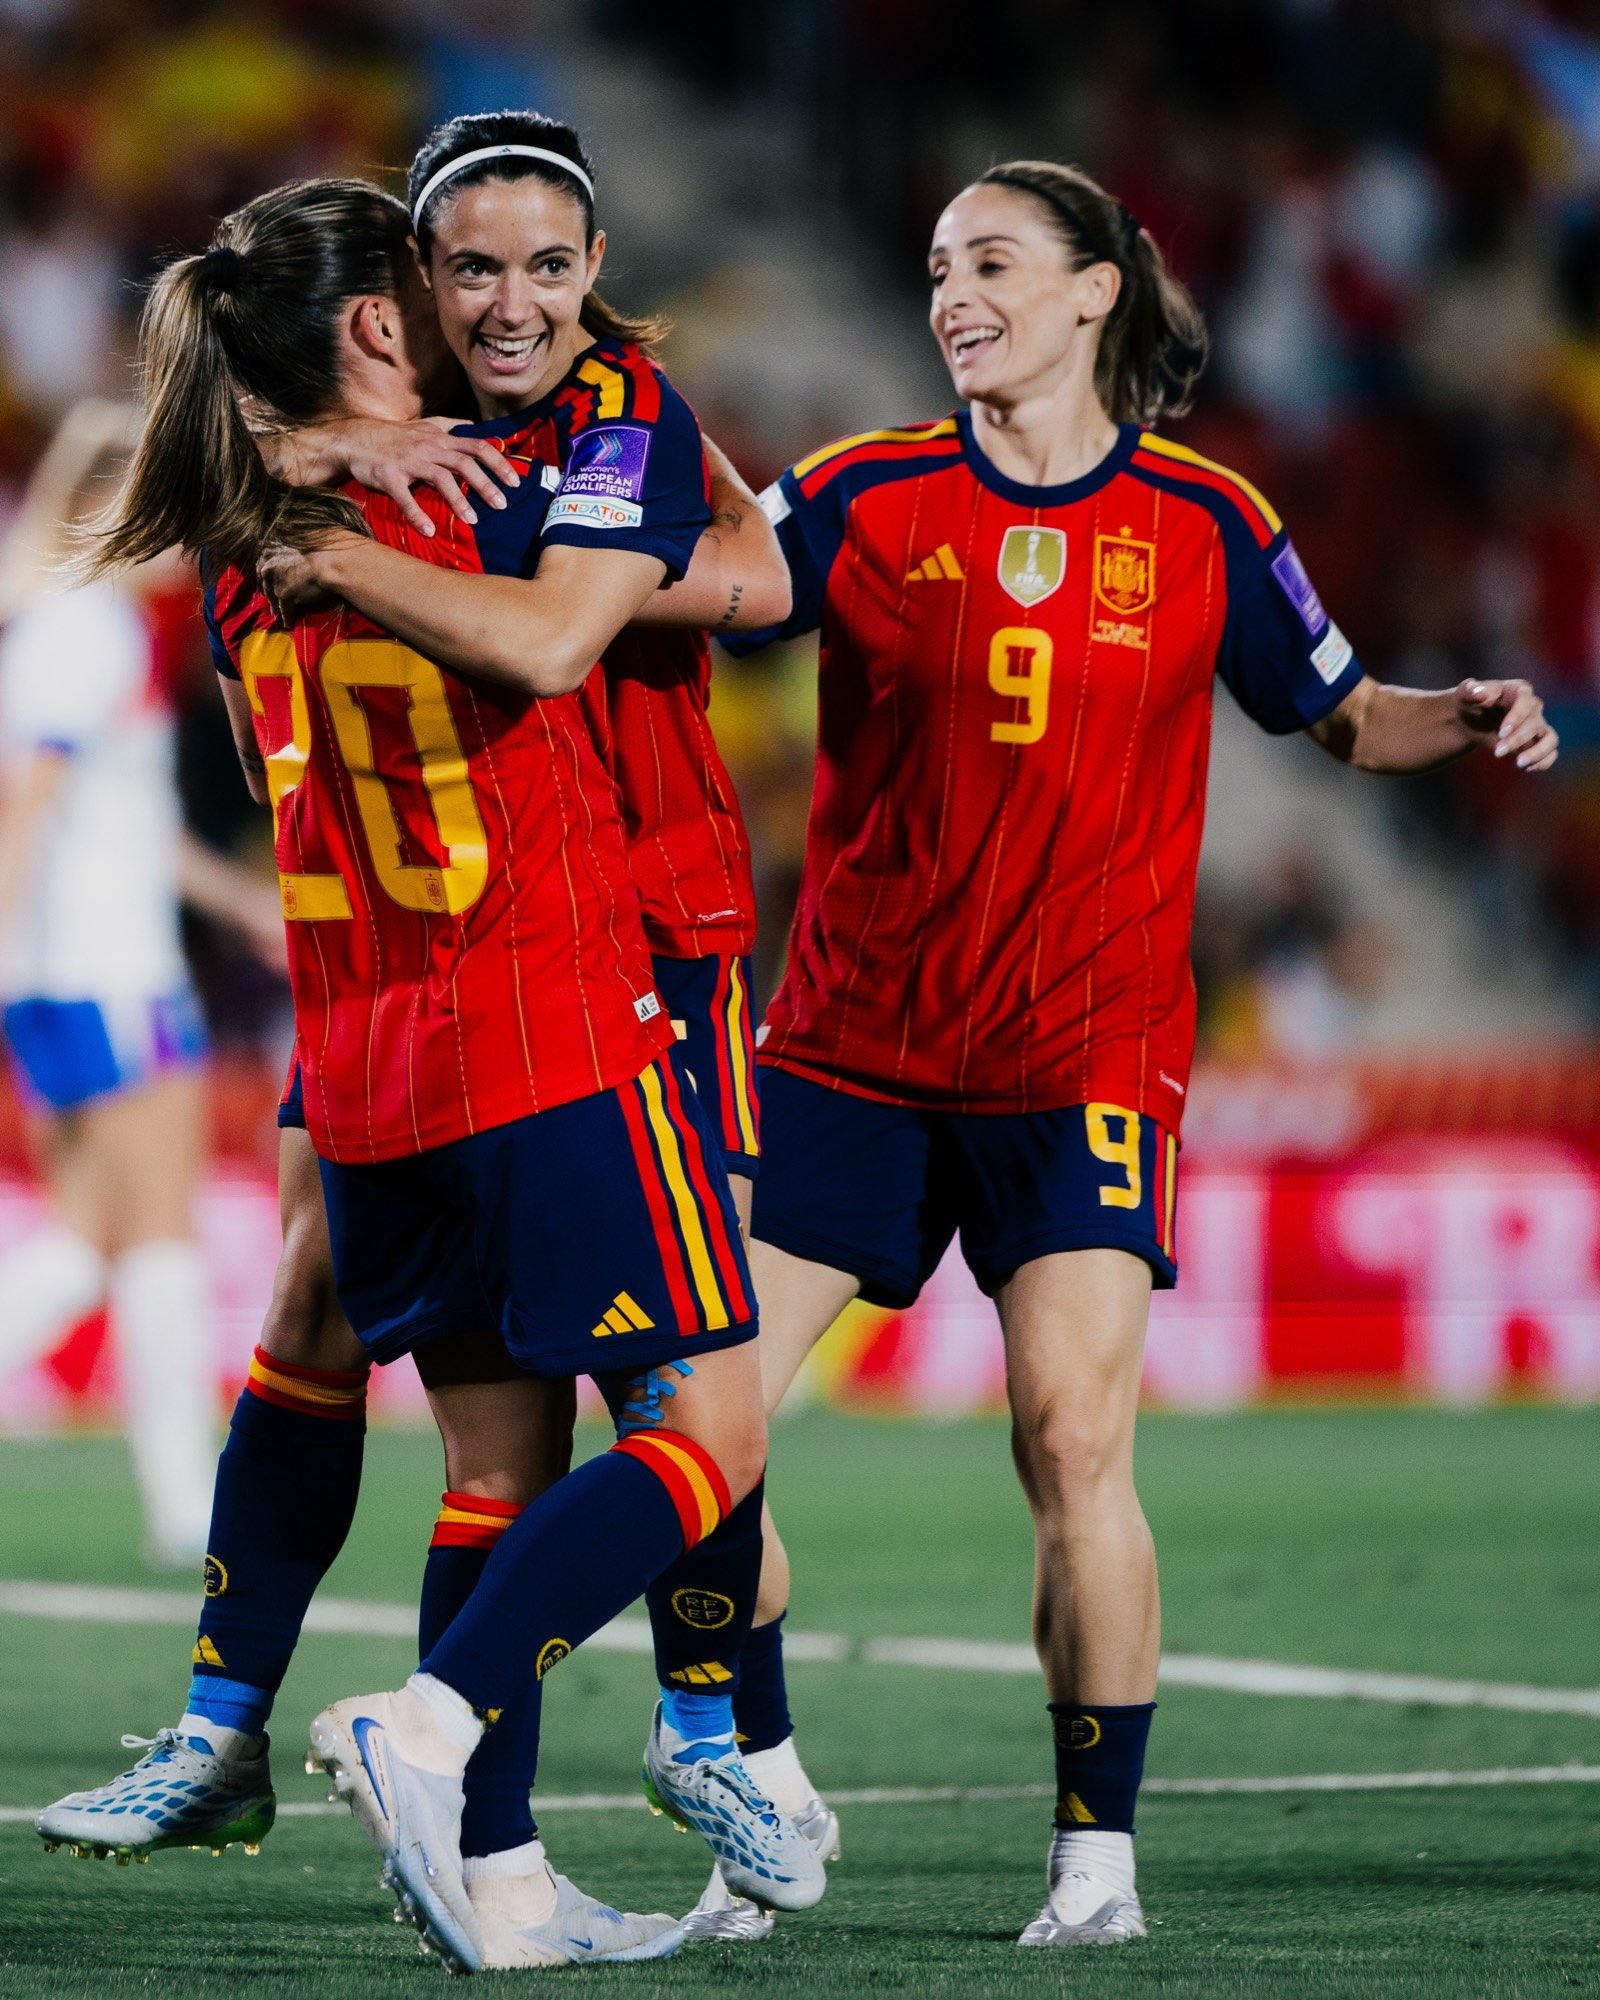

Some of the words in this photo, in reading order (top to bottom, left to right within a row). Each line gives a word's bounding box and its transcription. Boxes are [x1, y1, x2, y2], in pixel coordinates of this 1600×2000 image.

[562, 482, 633, 498] QUALIFIERS
[566, 473, 633, 488] EUROPEAN
[580, 466, 620, 475] women's
[987, 626, 1054, 745] 9
[239, 629, 489, 922] 20
[1085, 1102, 1142, 1210] 9
